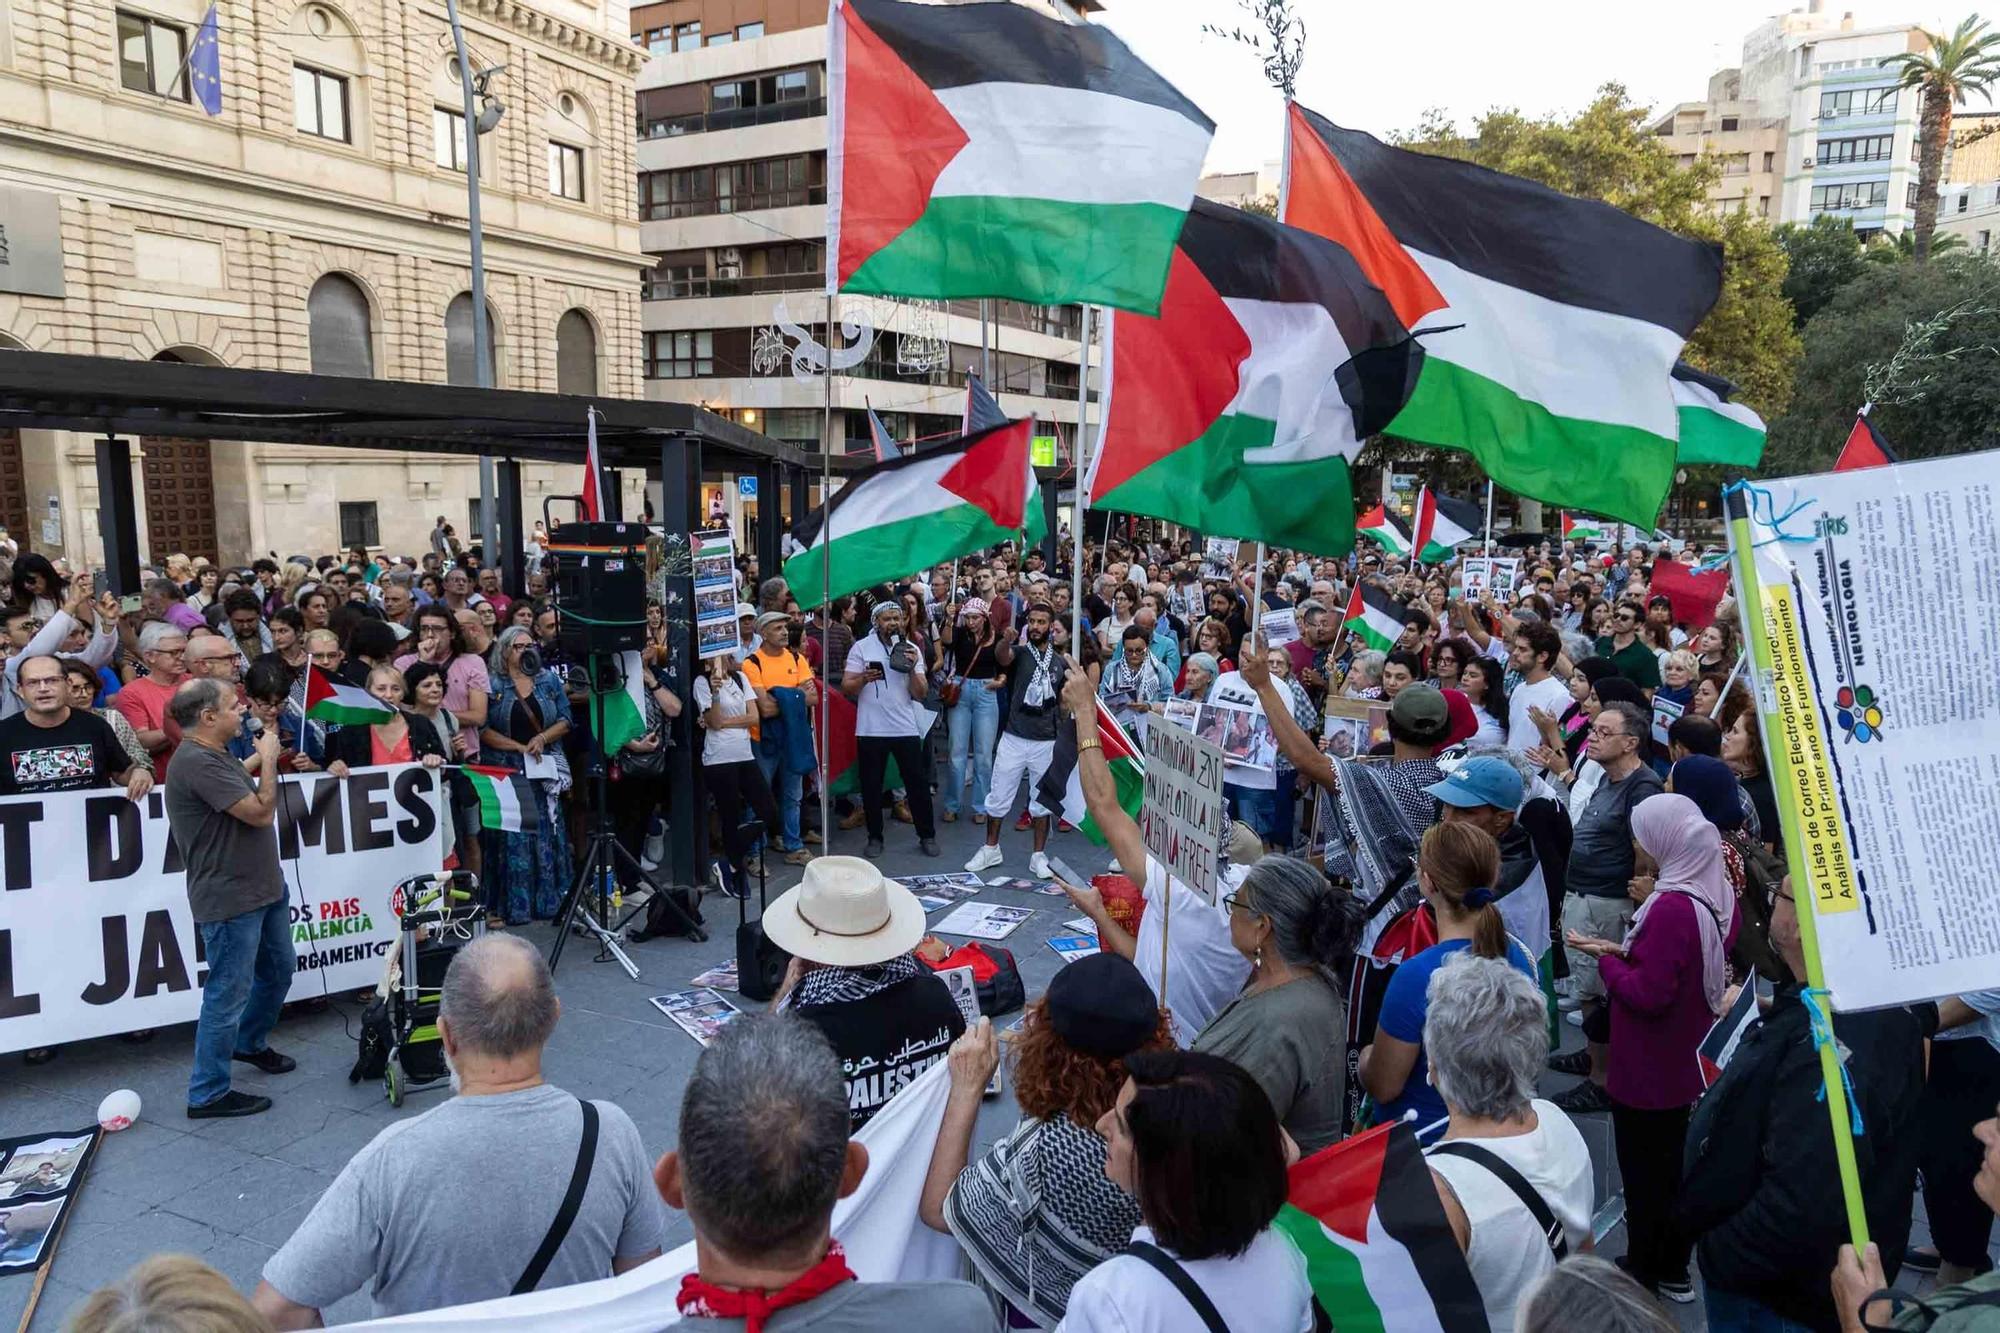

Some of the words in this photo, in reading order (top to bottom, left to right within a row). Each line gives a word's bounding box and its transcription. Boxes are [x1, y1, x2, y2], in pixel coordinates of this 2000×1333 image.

[1814, 549, 1828, 598] Virtual
[1466, 588, 1499, 600] BAA
[1839, 559, 1864, 666] NEUROLOGIA
[1779, 599, 1805, 708] Funcionamiento
[1779, 685, 1804, 764] Electrónico
[1803, 713, 1813, 730] de
[1797, 769, 1814, 817] Correo
[1814, 765, 1832, 811] Primer
[1807, 821, 1819, 838] de
[1823, 815, 1837, 836] del
[1812, 843, 1828, 877] Lista
[1830, 841, 1851, 898] Análisis
[1821, 882, 1833, 899] La
[294, 942, 373, 972] RGAMENT
